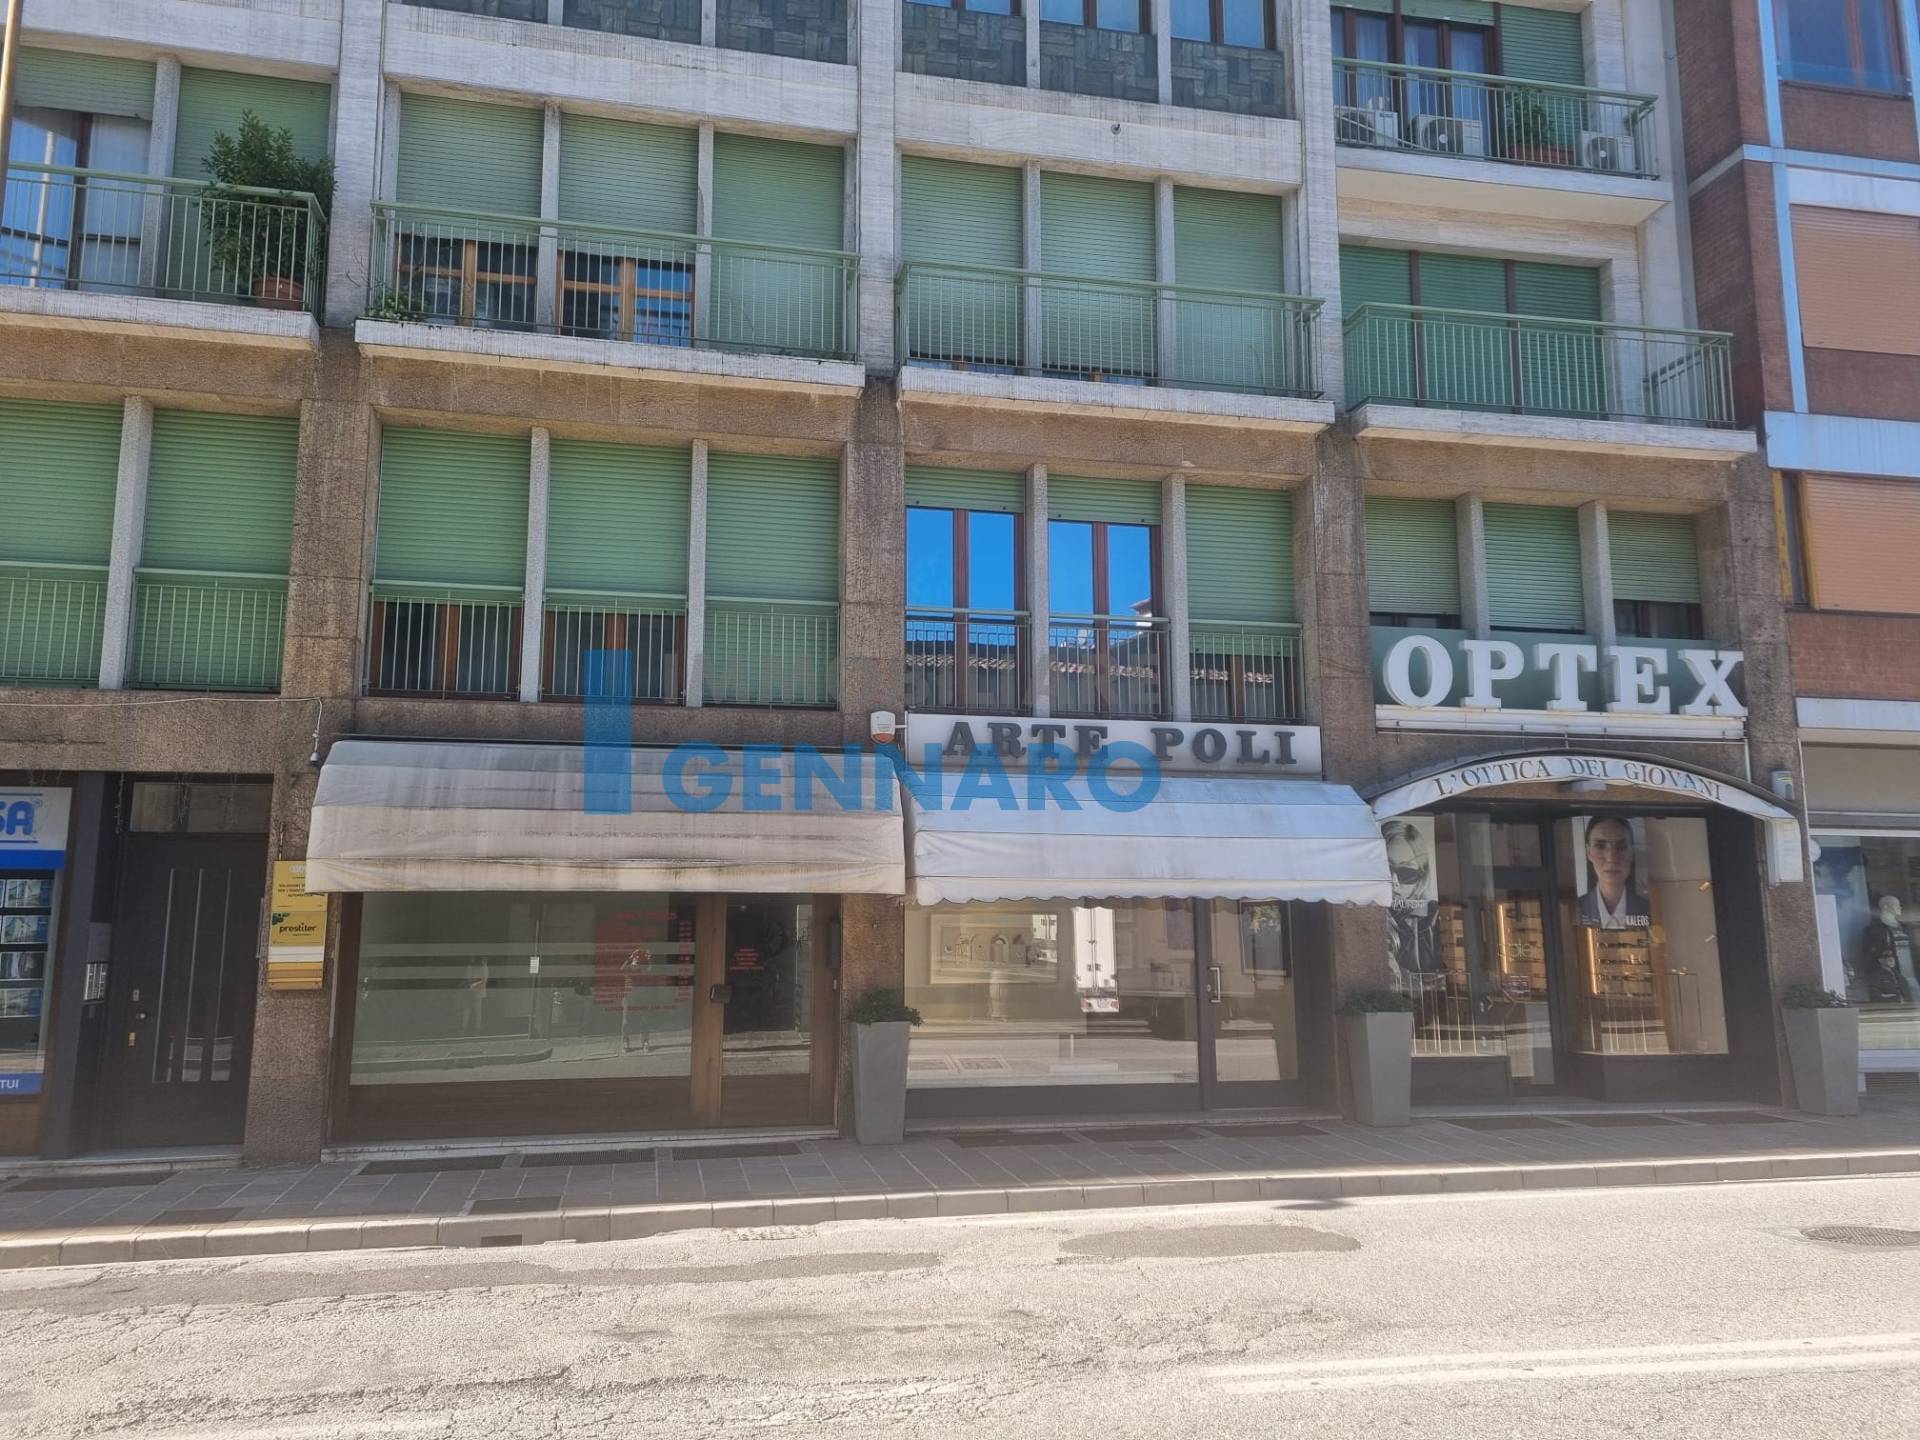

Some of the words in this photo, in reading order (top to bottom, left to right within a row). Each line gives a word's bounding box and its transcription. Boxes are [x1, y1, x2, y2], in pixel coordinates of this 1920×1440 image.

[1383, 635, 1747, 717] OPTEX
[943, 721, 1108, 759] ARTE
[1151, 727, 1297, 765] POLI
[1434, 759, 1551, 796] L'OTTICA
[1565, 758, 1609, 777] DEI
[1624, 763, 1721, 801] GIOVANI
